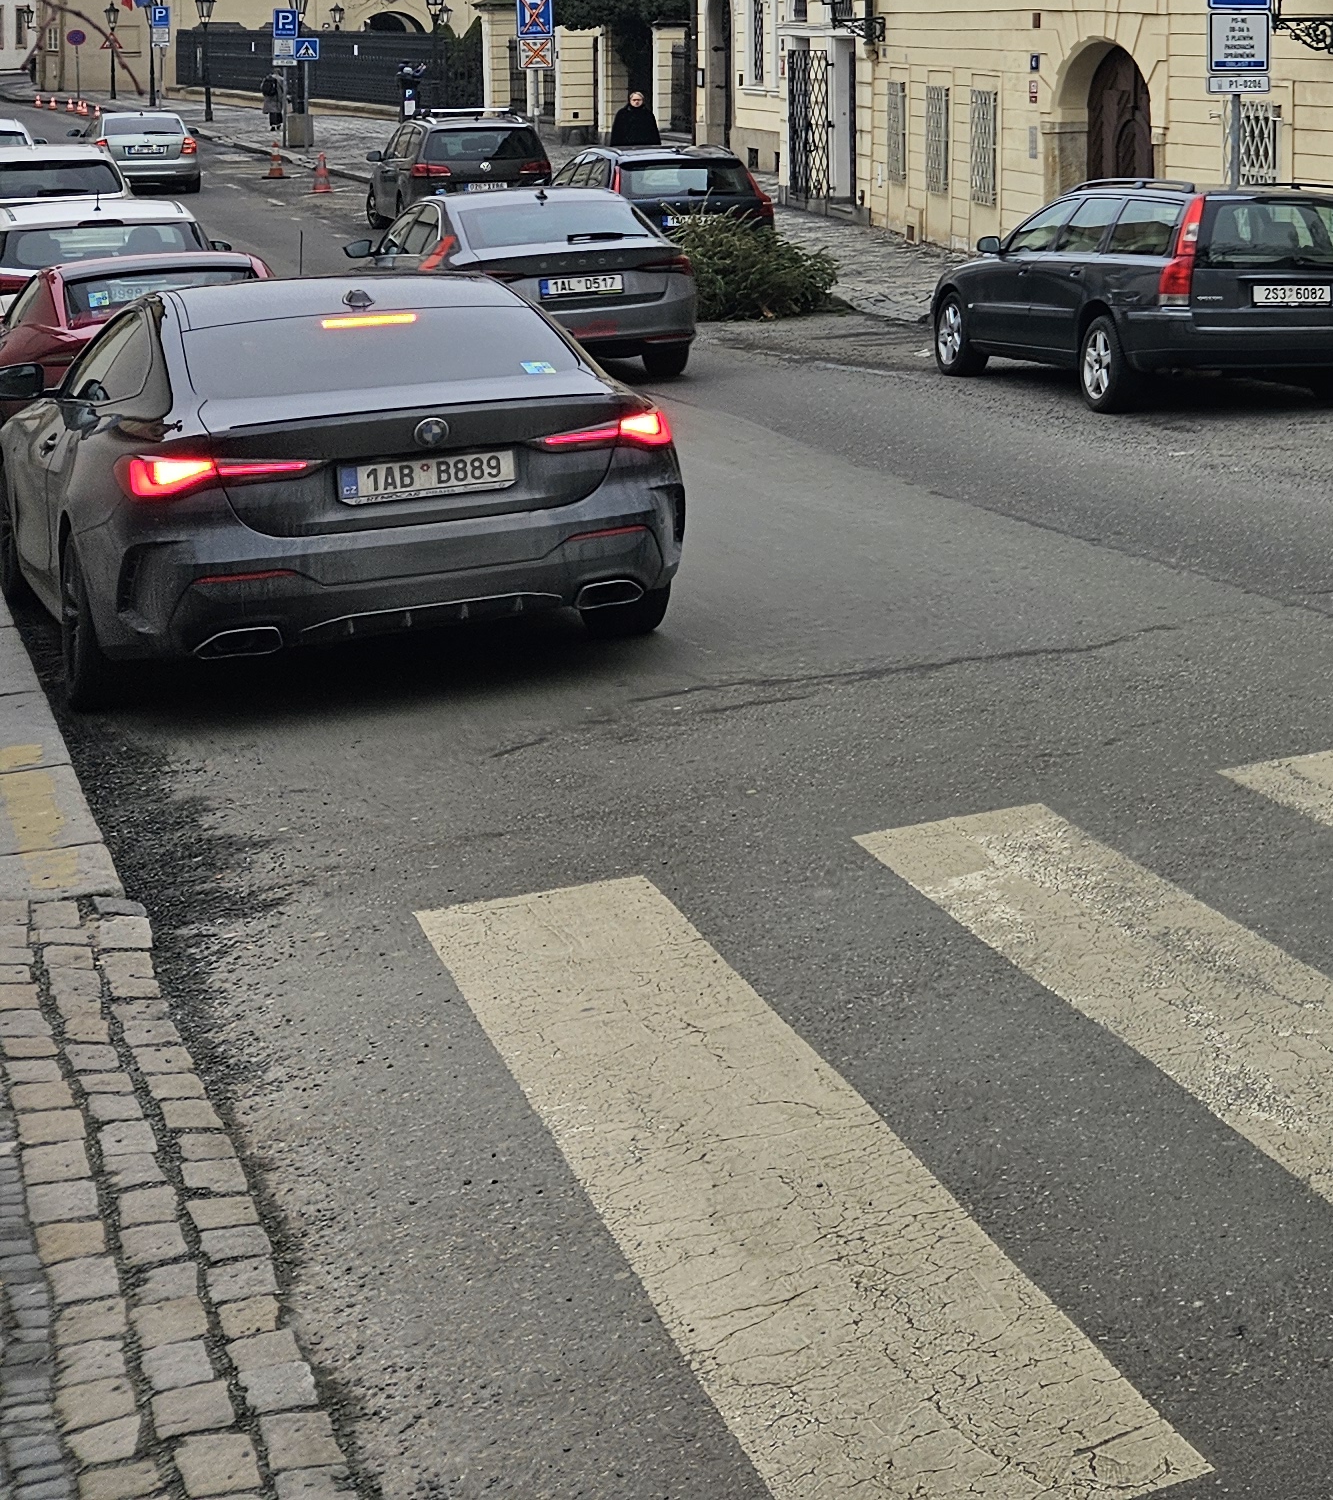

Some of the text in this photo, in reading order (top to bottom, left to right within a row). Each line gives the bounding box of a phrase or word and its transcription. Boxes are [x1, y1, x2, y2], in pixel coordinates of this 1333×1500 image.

[155, 8, 167, 21] P
[278, 12, 293, 30] P
[1228, 79, 1262, 89] P1-0206
[552, 276, 616, 293] 1AL D517
[1264, 287, 1325, 300] 2S3 6082
[366, 454, 502, 492] 1AB B889
[343, 486, 357, 495] CZ
